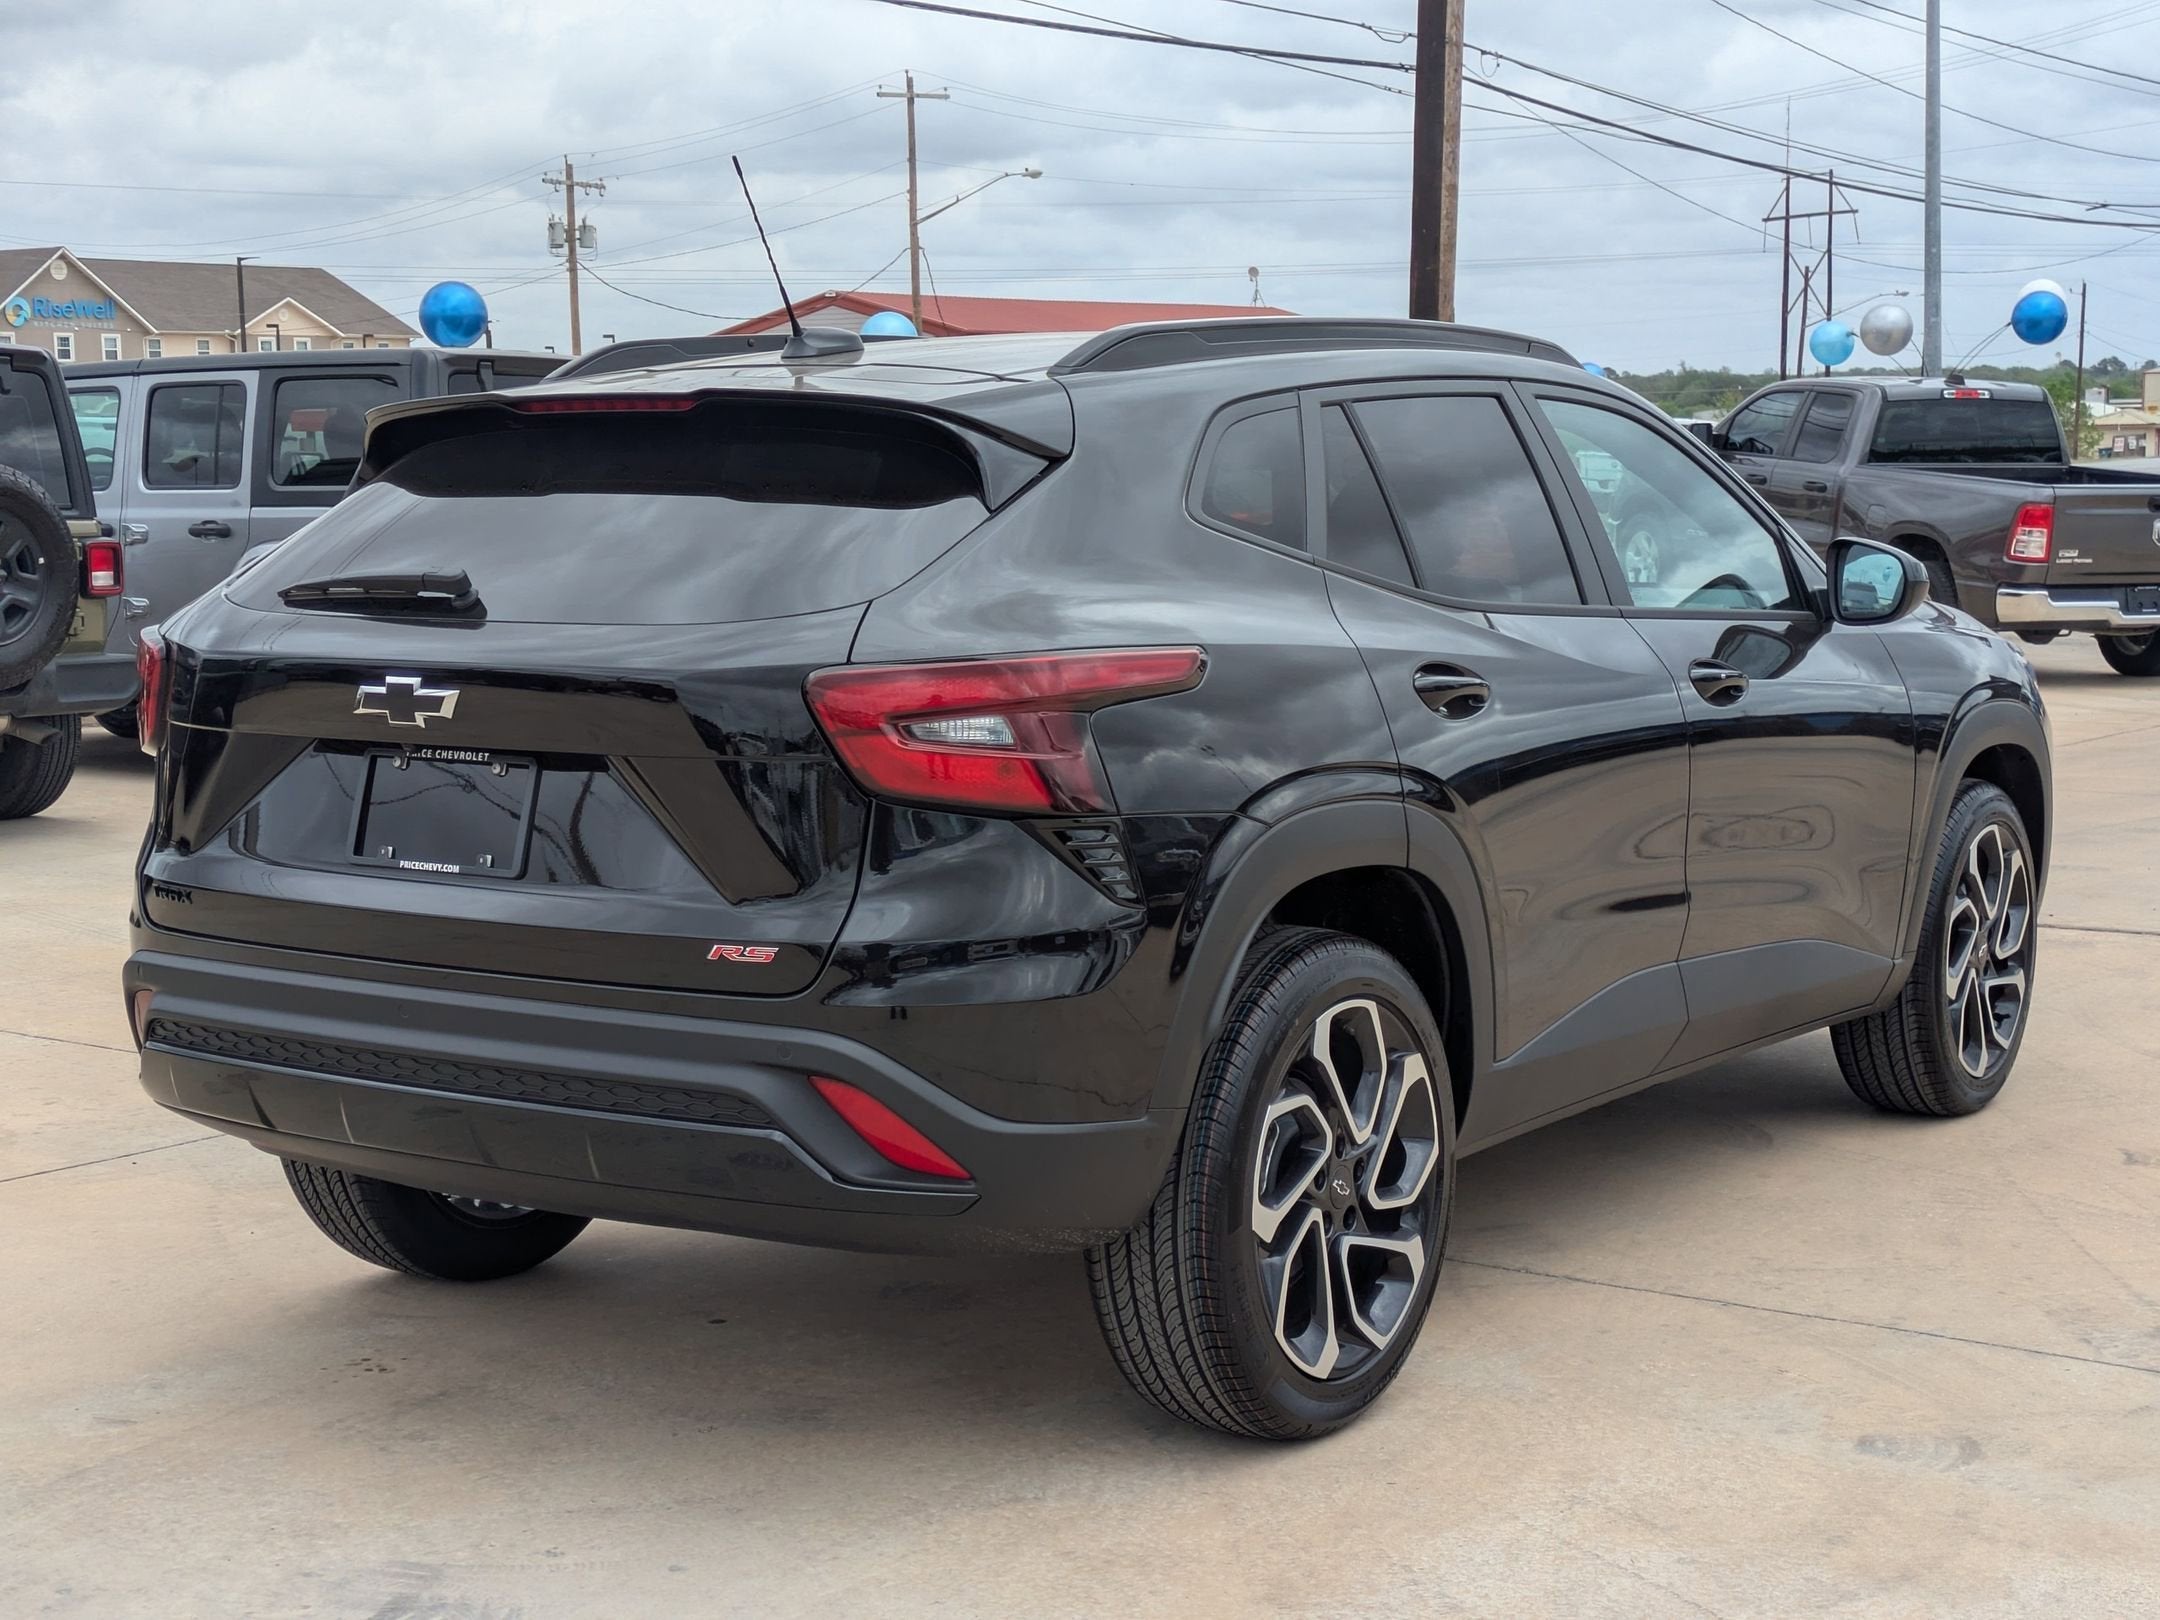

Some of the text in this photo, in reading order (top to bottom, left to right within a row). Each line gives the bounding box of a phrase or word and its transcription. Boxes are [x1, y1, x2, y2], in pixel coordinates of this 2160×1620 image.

[32, 296, 115, 320] RiseWell
[435, 750, 489, 761] CHEVROLET
[400, 860, 460, 873] PRICECHEVY.COM
[706, 944, 780, 963] RS
